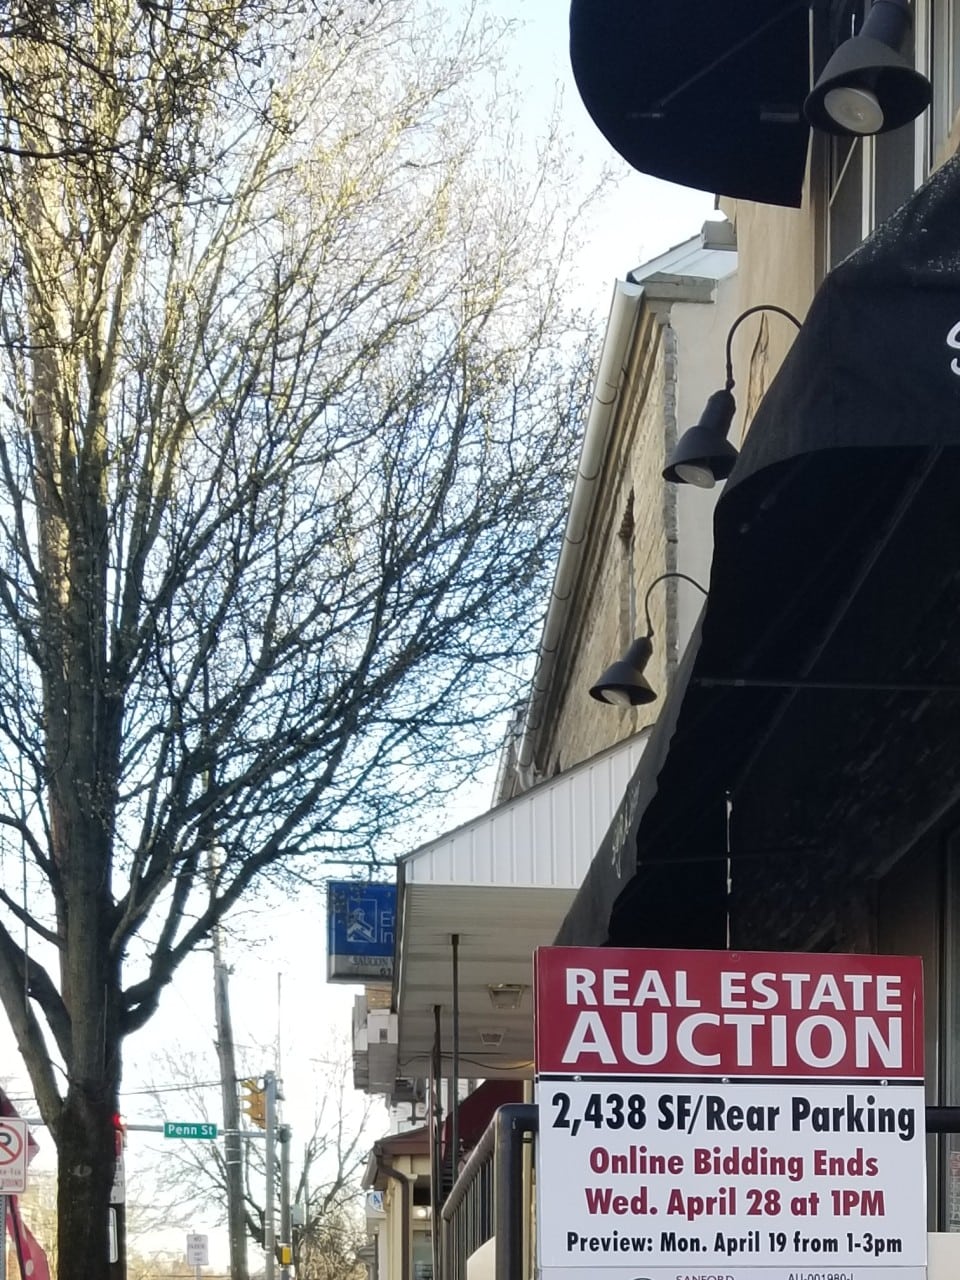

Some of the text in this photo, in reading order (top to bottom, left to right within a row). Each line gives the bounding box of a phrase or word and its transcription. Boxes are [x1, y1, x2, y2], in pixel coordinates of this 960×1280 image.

[565, 968, 902, 1011] REAL ESTATE
[561, 1011, 903, 1069] AUCTION
[168, 1124, 213, 1135] Penn St
[551, 1092, 915, 1140] 2,438 SF/Rear Parking
[589, 1146, 879, 1181] Online Bidding Ends
[585, 1188, 886, 1221] Wed. April 28 at 1PM
[567, 1232, 902, 1256] Preview: Mon. April 19 from 1-3pm
